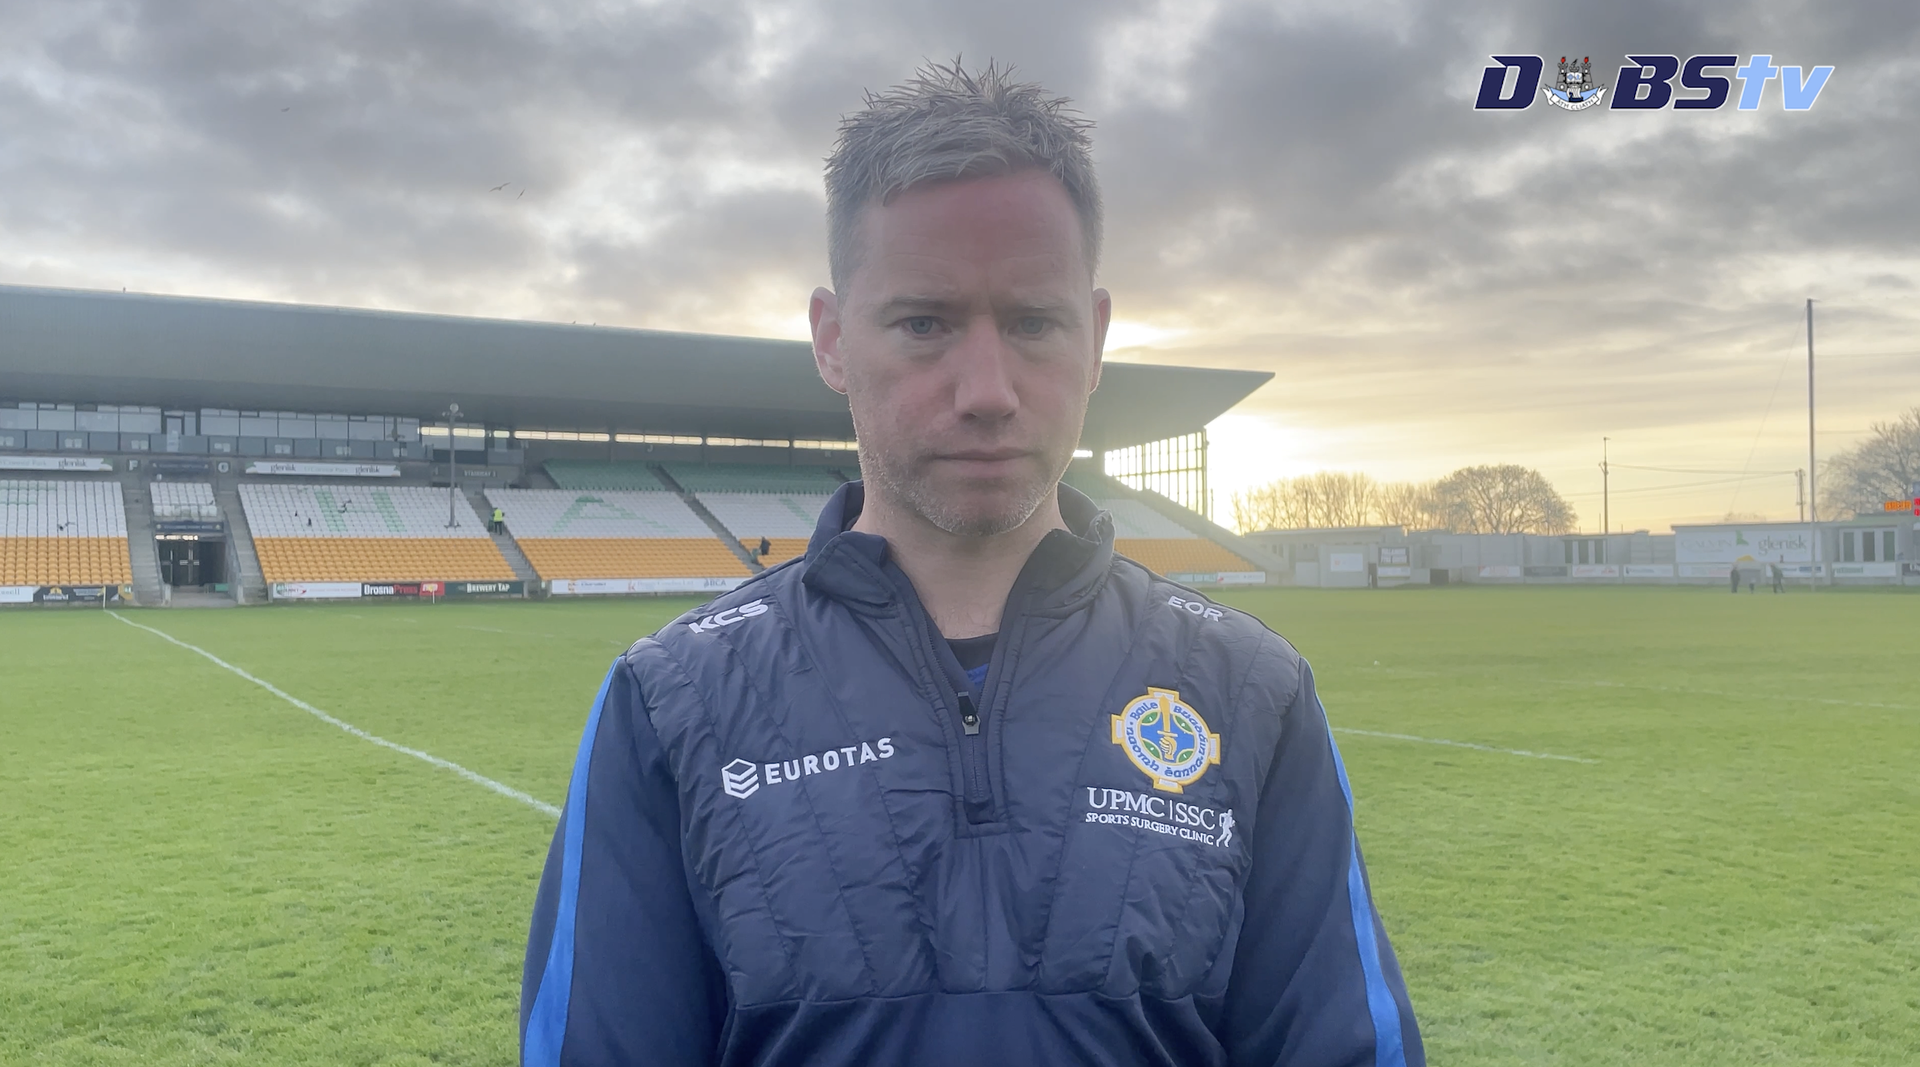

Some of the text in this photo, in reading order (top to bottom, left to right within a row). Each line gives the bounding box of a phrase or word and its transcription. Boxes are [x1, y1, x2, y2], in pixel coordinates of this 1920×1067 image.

[688, 598, 769, 634] KCS
[1167, 595, 1223, 622] EOR
[764, 737, 895, 785] EUROTAS
[1085, 812, 1215, 845] SPORTS SURGERY CLINIC
